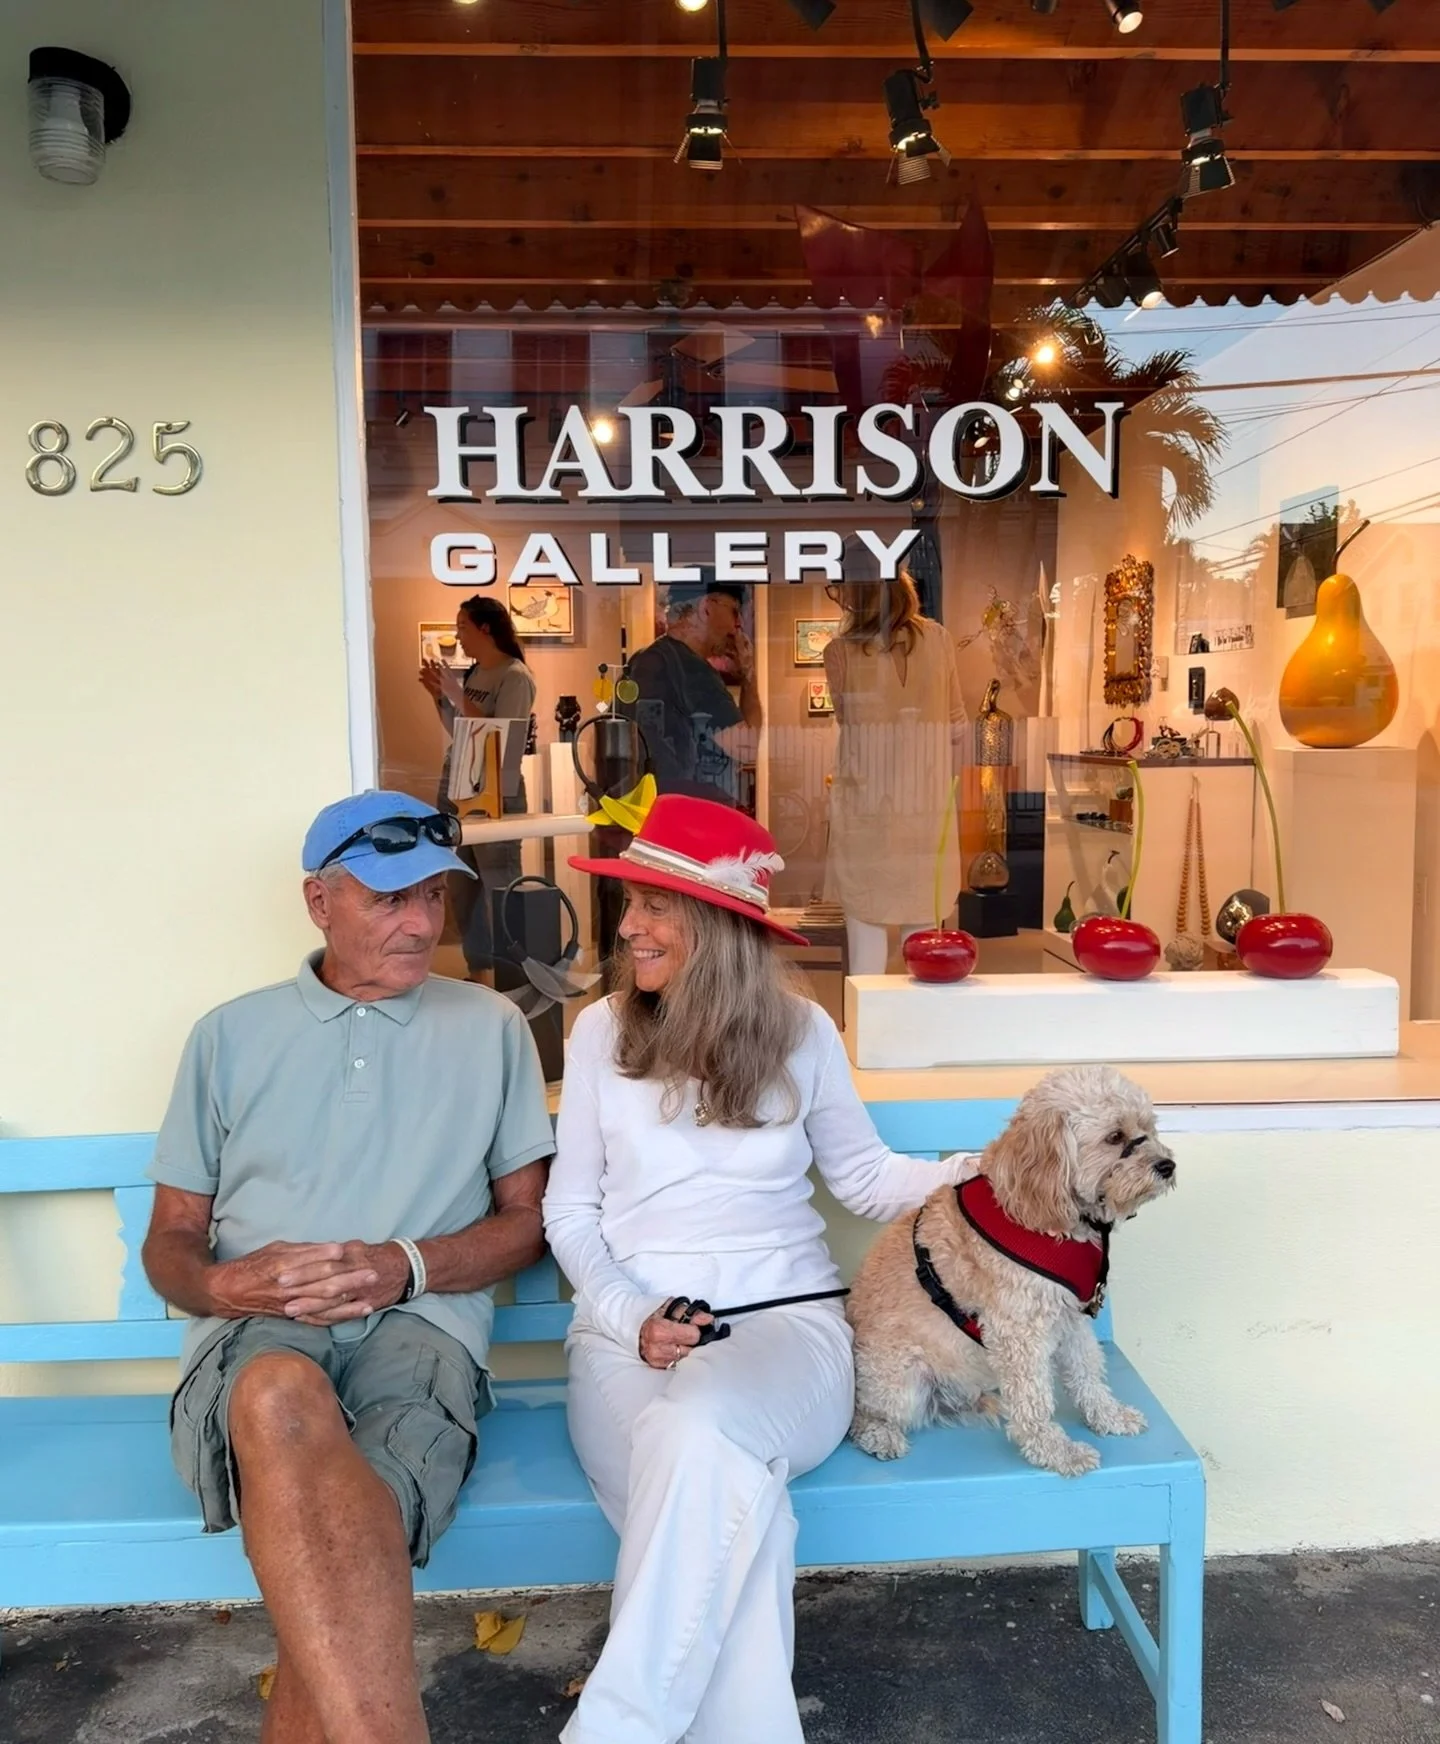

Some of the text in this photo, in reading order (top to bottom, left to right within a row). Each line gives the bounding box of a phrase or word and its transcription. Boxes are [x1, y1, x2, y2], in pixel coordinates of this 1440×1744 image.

[25, 416, 204, 497] 825
[424, 401, 1127, 502] HARRISON
[429, 529, 921, 586] GALLERY
